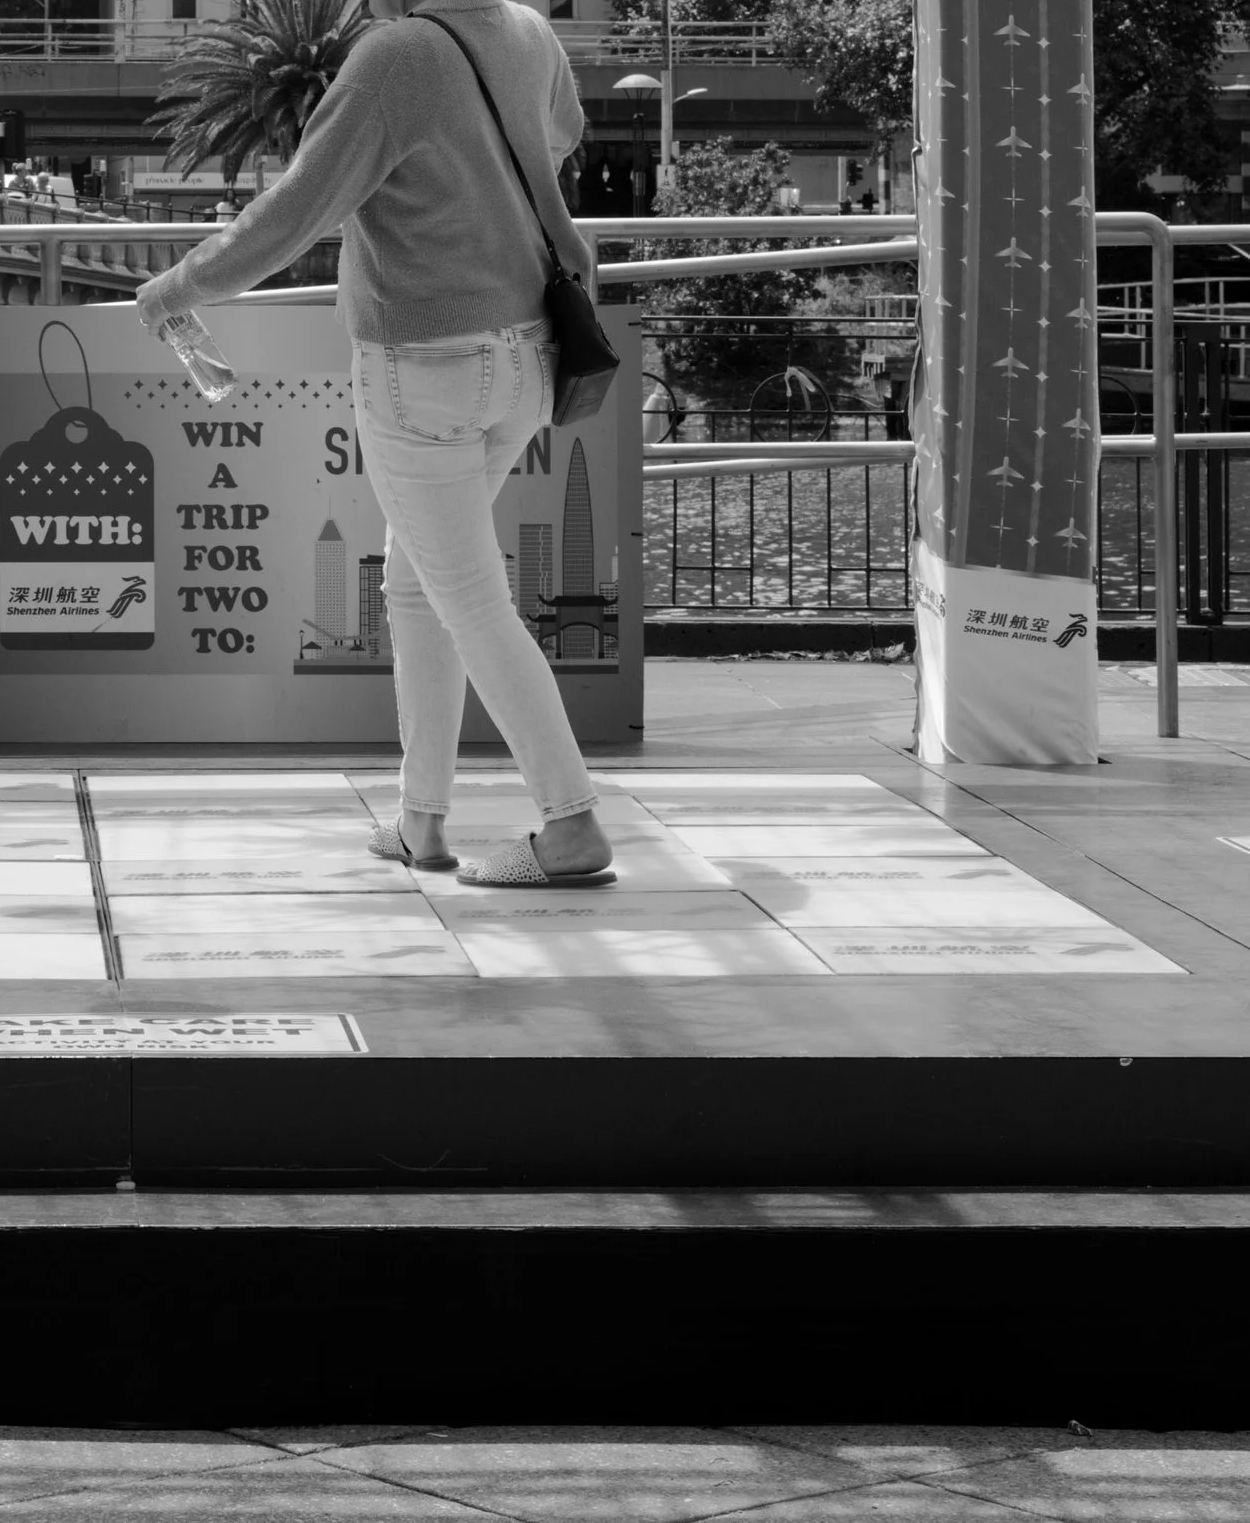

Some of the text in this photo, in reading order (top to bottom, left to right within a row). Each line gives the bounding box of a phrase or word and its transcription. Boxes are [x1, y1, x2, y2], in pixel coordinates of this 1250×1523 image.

[181, 422, 263, 447] WIN
[208, 463, 238, 488] A
[176, 504, 269, 530] TRIP
[10, 515, 142, 545] WITH:
[183, 545, 263, 571] FOR
[8, 586, 100, 604] 深圳航空
[177, 586, 268, 612] TWO
[6, 606, 100, 616] Shenzhen Airlines
[966, 608, 1049, 633] 深圳航空
[191, 628, 255, 653] TO:
[963, 625, 1047, 643] Shenzhen Airlines
[139, 1018, 314, 1026] CARE
[169, 1028, 312, 1036] WET
